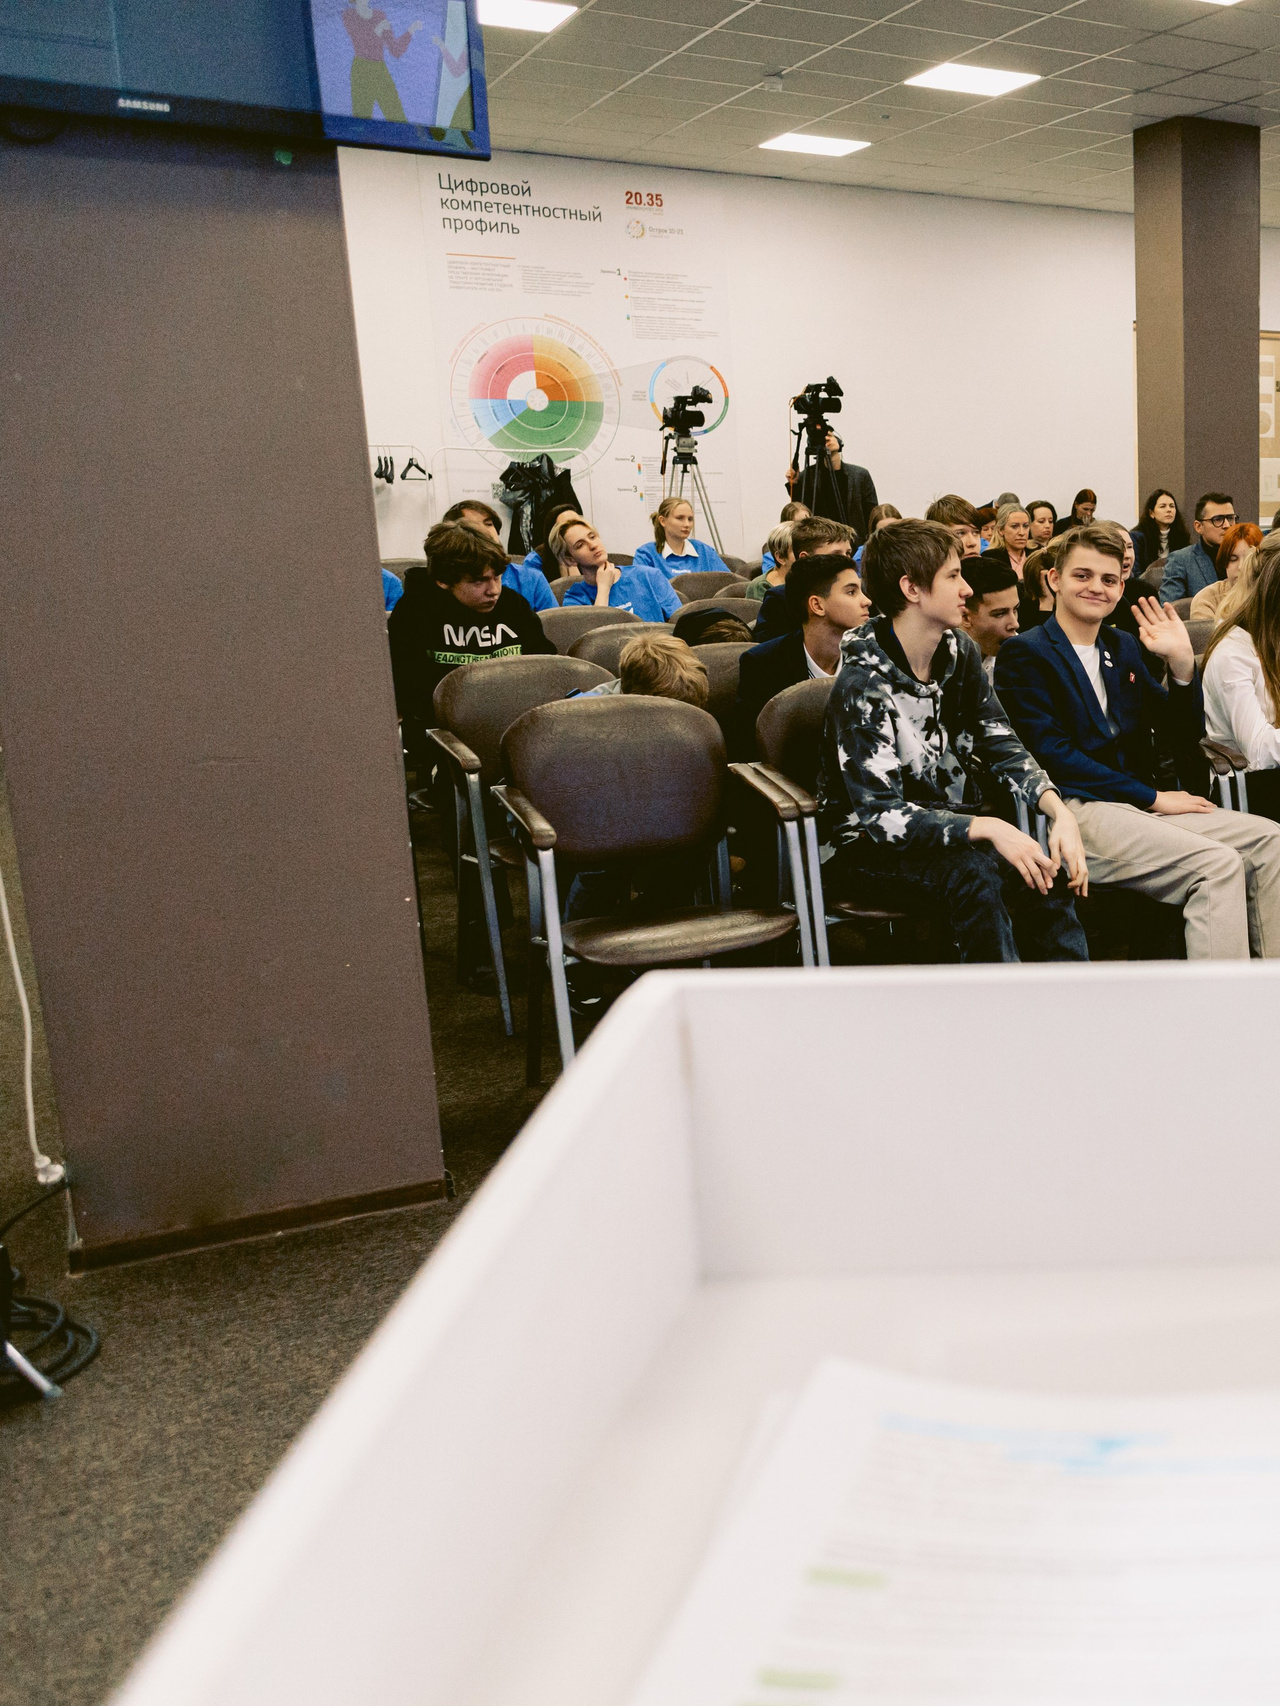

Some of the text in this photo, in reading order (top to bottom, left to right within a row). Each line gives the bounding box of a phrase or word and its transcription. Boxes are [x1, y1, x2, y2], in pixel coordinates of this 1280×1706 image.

[118, 98, 170, 112] SAMSUNG
[438, 172, 532, 197] Цифровой
[625, 190, 663, 208] 20.35
[440, 198, 603, 222] компетентностный
[442, 217, 520, 235] профиль
[616, 268, 621, 276] 1
[633, 485, 638, 493] 3
[443, 623, 518, 647] NASA
